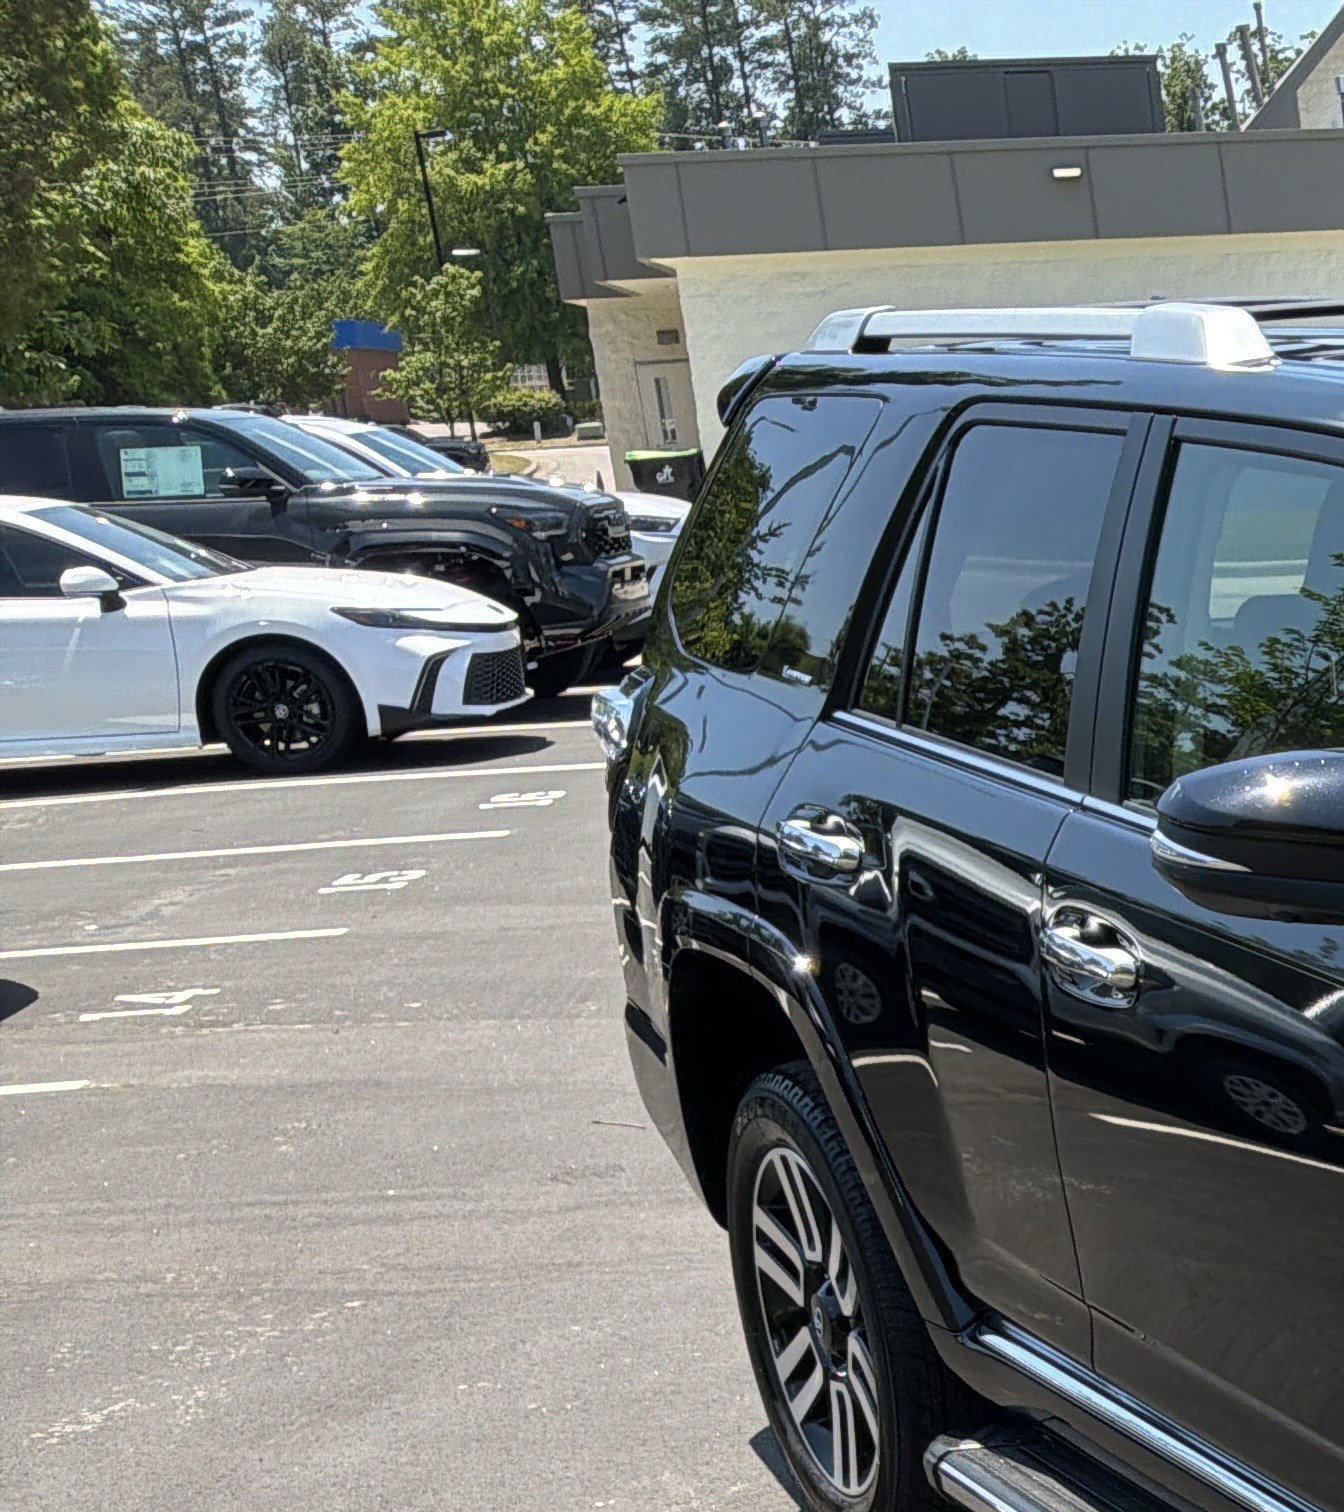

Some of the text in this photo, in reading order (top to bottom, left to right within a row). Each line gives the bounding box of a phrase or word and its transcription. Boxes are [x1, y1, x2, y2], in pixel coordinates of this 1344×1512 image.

[478, 790, 567, 810] 16
[317, 868, 427, 895] 15
[78, 987, 222, 1022] 14
